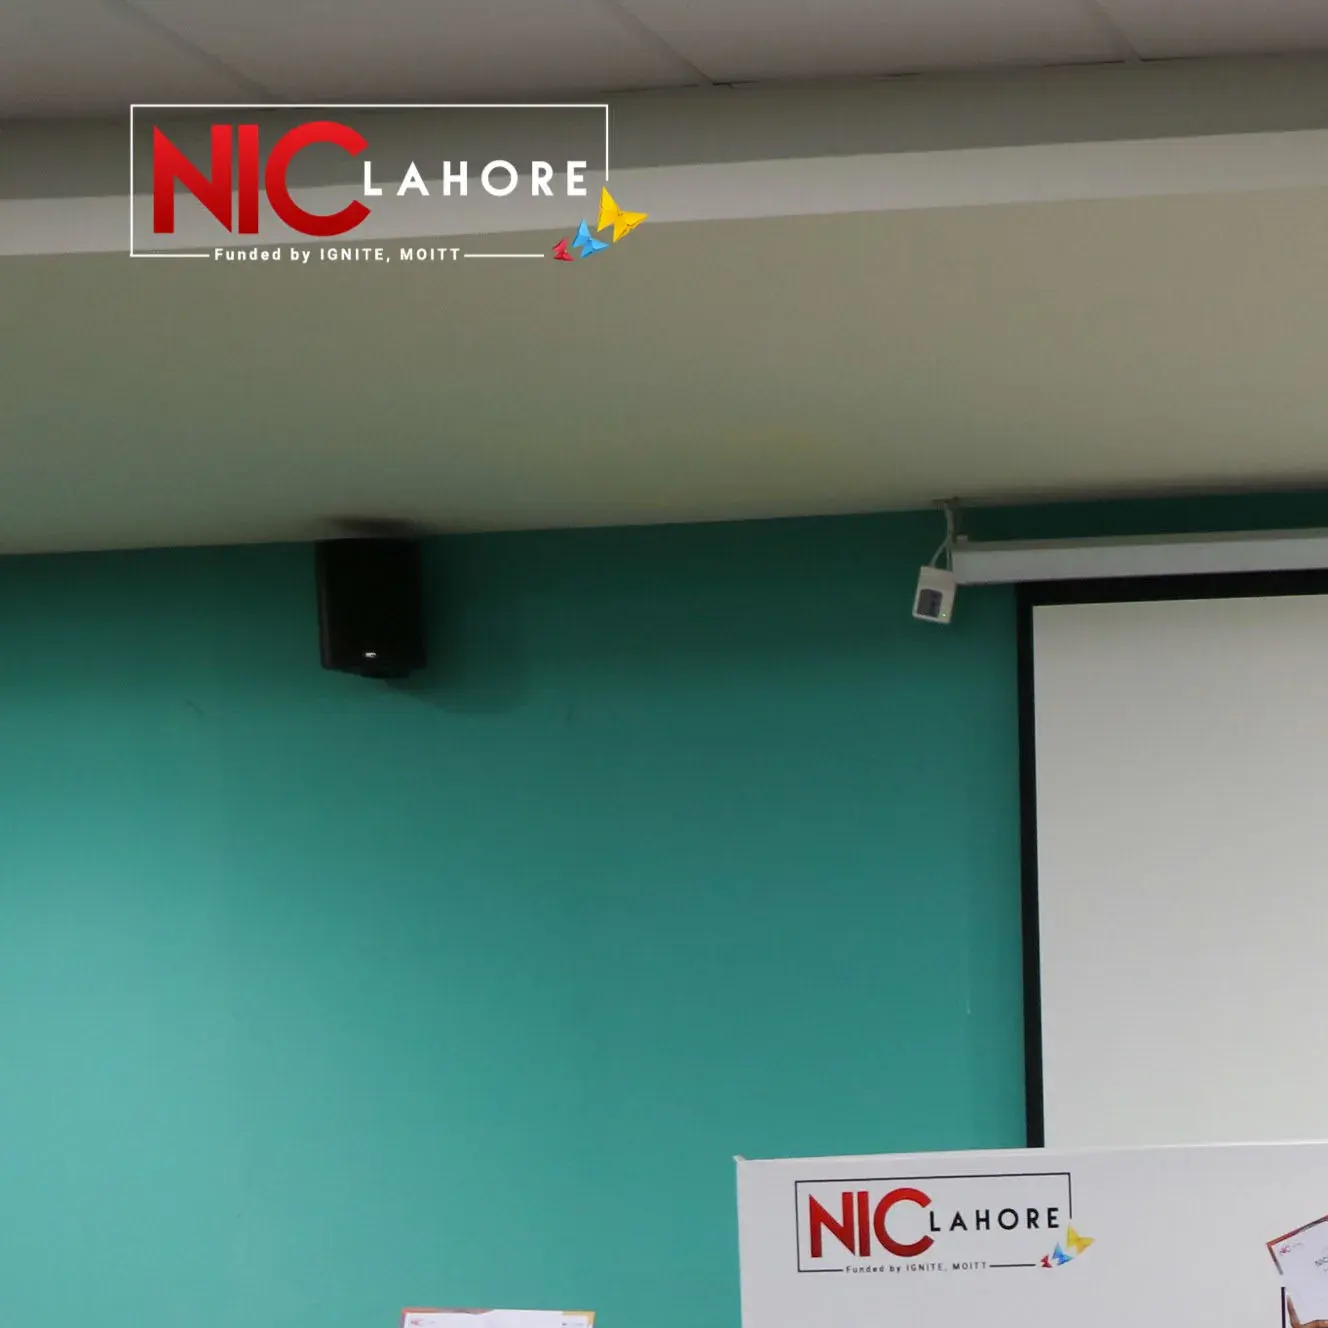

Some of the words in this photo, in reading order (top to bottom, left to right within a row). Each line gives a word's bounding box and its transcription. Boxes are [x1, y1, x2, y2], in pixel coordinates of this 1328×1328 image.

[809, 1187, 934, 1258] NIC
[930, 1208, 1059, 1232] LAHORE
[846, 1265, 885, 1273] Funded
[889, 1264, 901, 1274] by
[952, 1262, 987, 1271] MOITT
